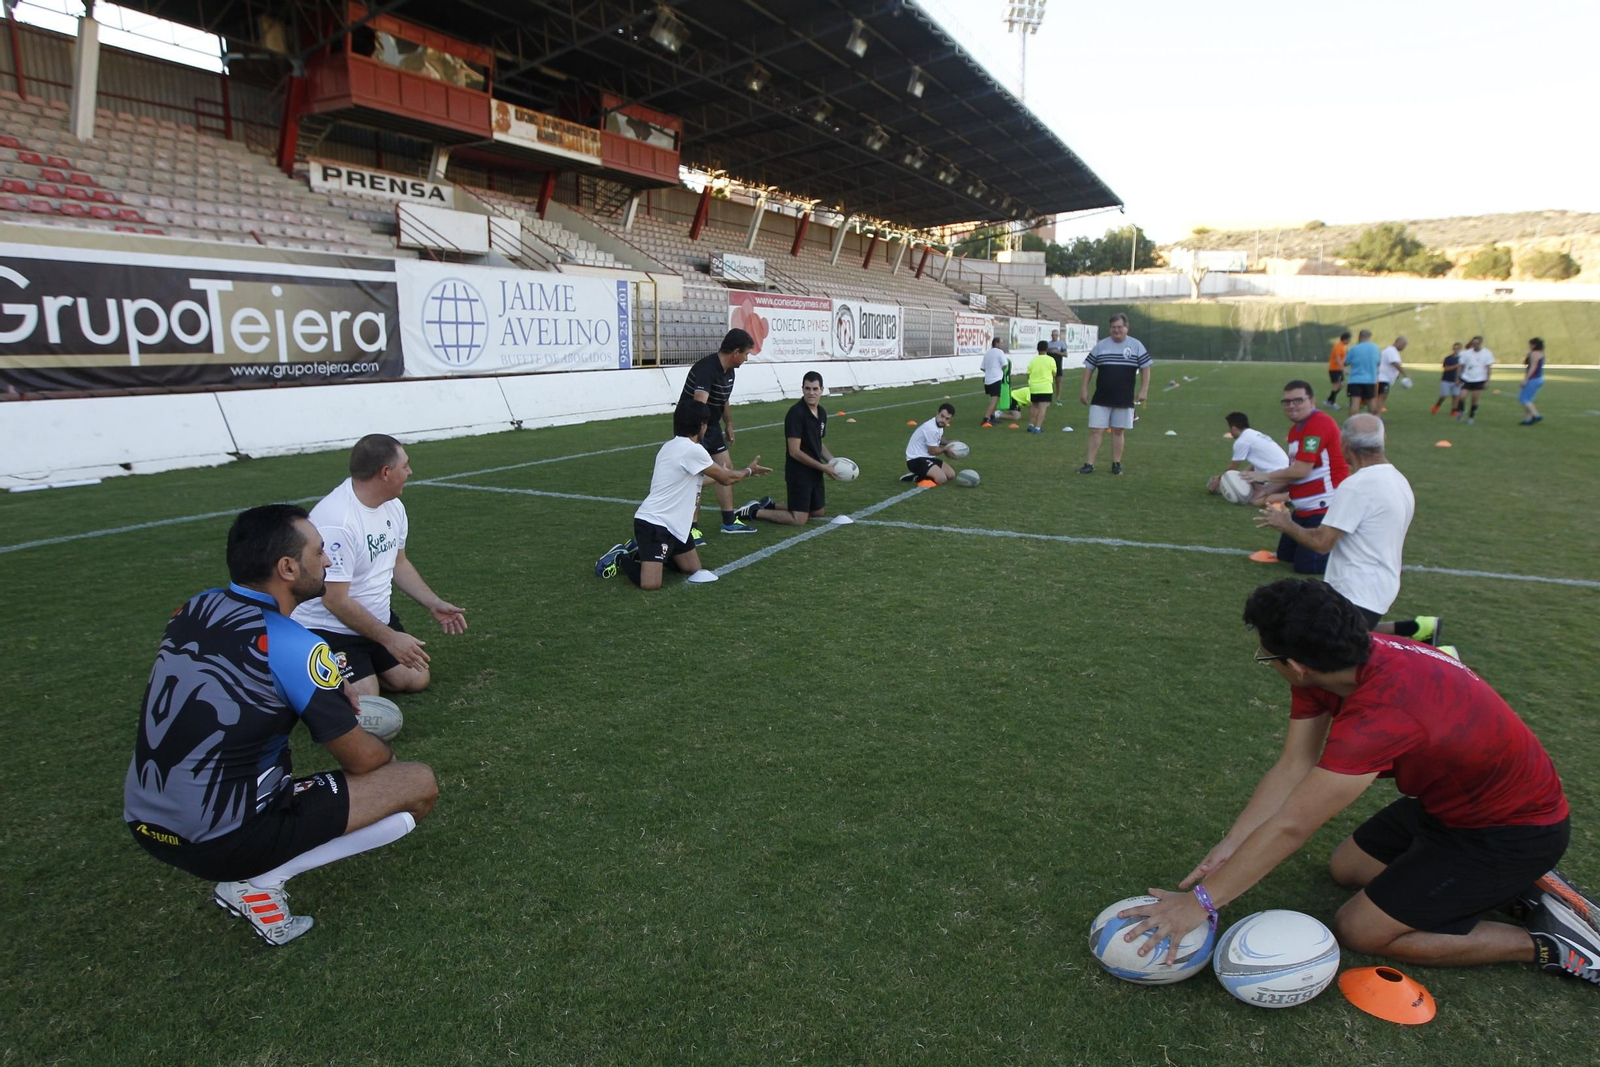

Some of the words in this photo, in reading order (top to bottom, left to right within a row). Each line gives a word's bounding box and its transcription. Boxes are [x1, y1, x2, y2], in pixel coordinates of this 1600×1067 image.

[321, 166, 446, 202] PRENSA
[498, 280, 577, 318] JAIME
[618, 287, 627, 307] 401
[755, 297, 830, 309] www.conectapymes.net
[500, 317, 611, 346] AVELINO
[619, 314, 628, 336] 251
[771, 318, 806, 332] CONECTA
[807, 319, 829, 332] PYMES
[859, 305, 897, 339] lamarca
[957, 328, 985, 346] RESPETO
[561, 352, 612, 364] ABOGADOS
[620, 339, 629, 363] 950
[229, 361, 380, 379] www.grupotejera.com
